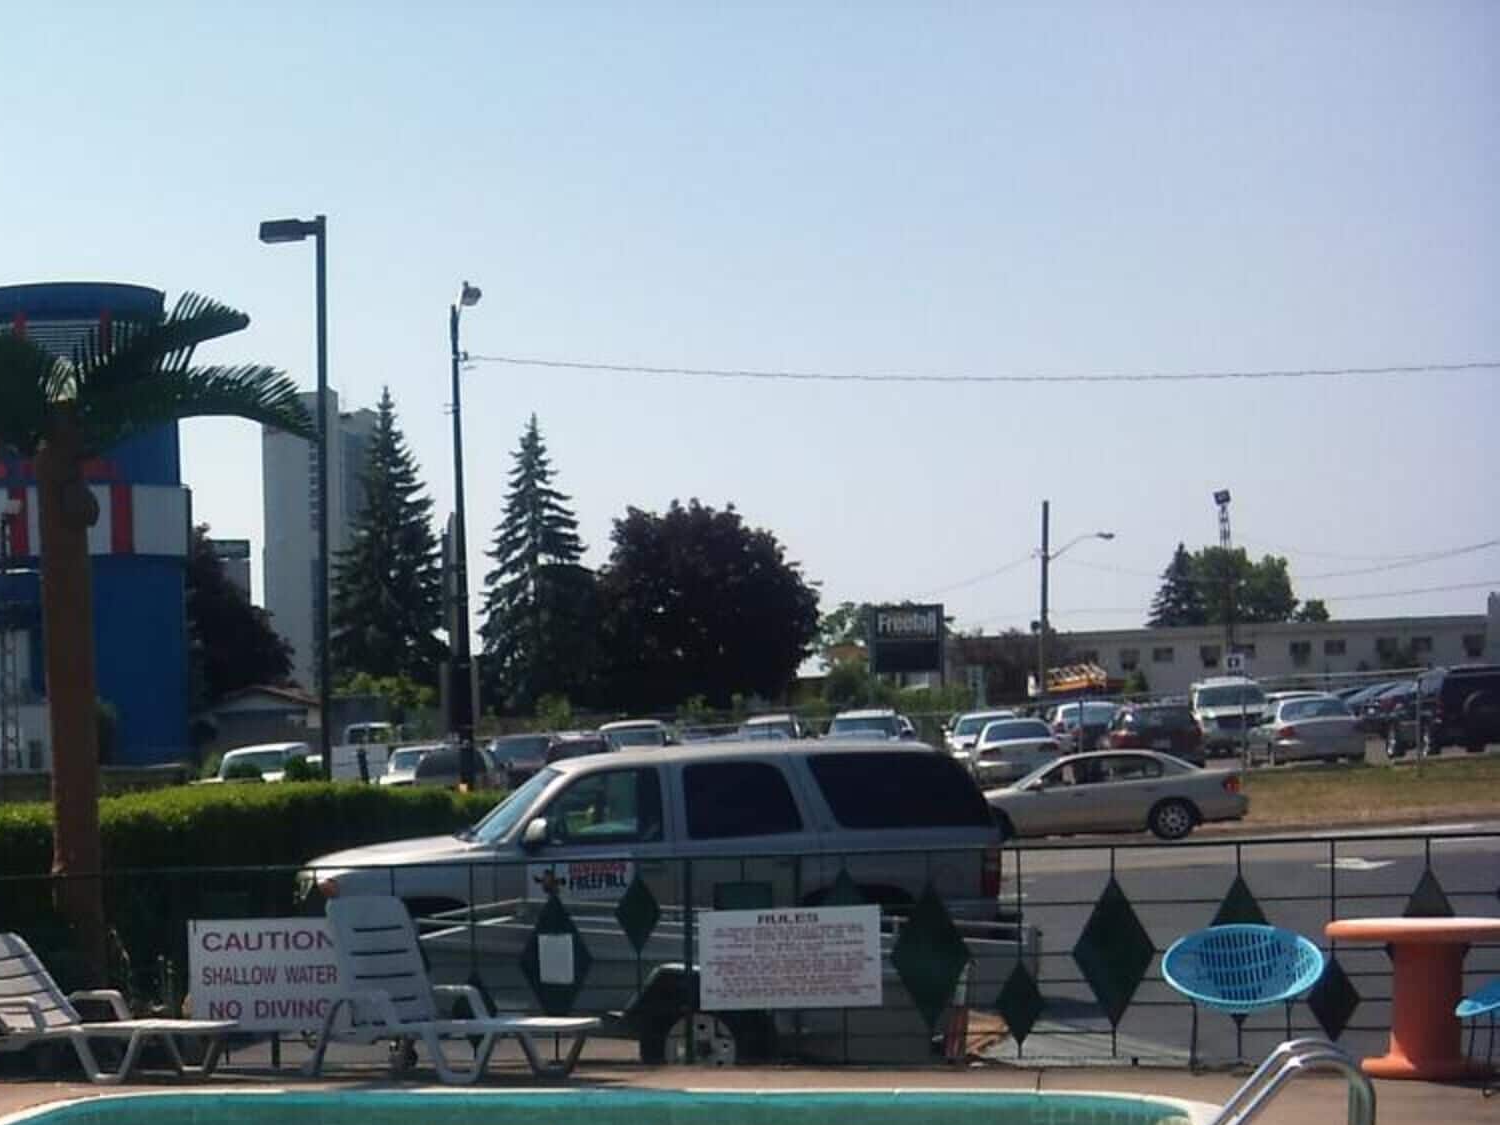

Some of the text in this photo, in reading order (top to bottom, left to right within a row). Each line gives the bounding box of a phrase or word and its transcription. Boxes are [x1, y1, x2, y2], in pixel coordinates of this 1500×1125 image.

[202, 930, 334, 952] CAUTION
[202, 964, 338, 985] SHALLOW WATER
[208, 1000, 242, 1020] NO
